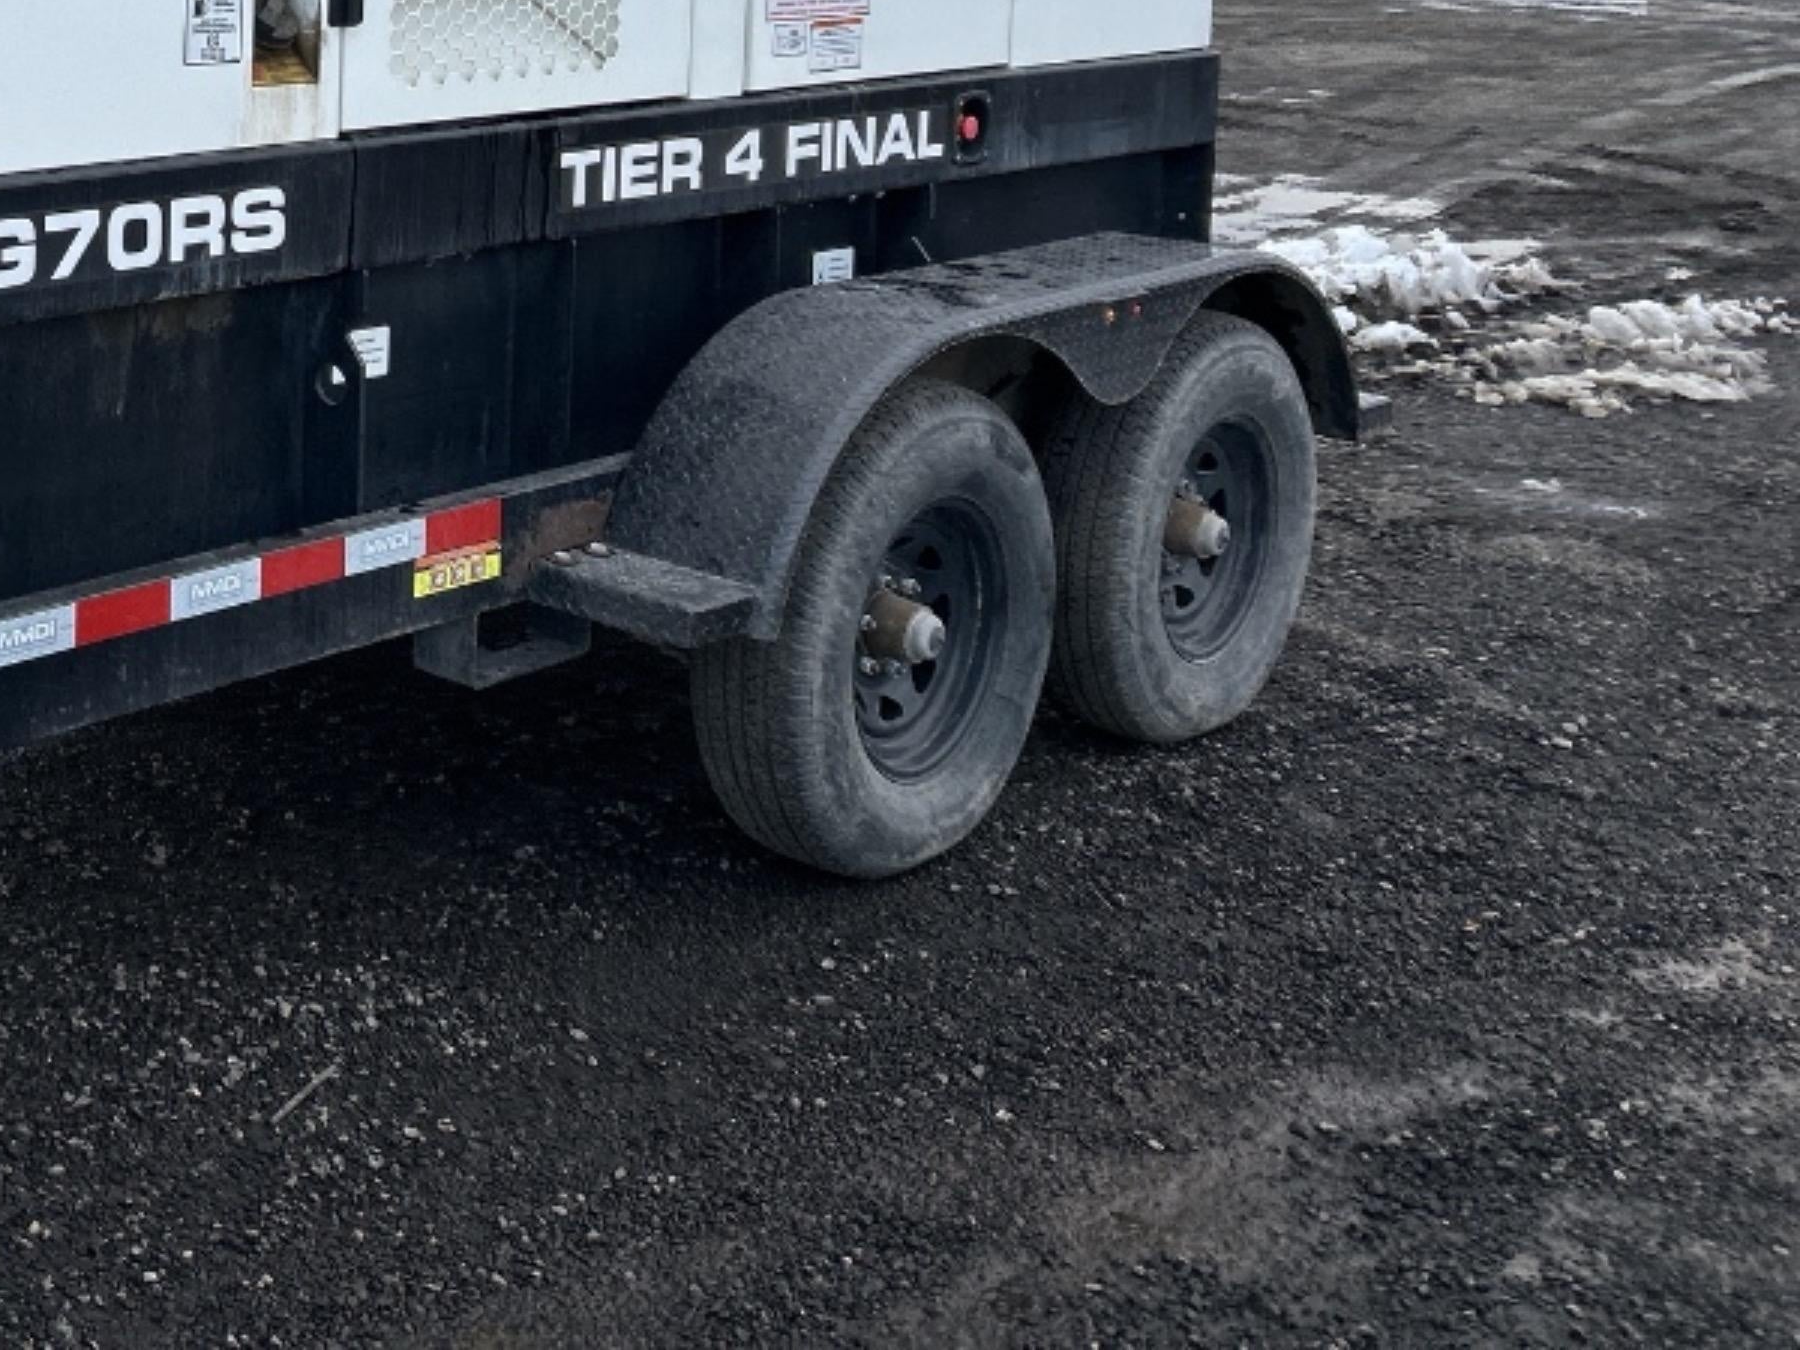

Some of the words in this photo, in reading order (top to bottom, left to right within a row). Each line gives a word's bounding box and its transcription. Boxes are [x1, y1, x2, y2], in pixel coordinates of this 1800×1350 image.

[561, 136, 704, 208] TIER
[724, 129, 764, 182] 4
[785, 110, 944, 178] FINAL
